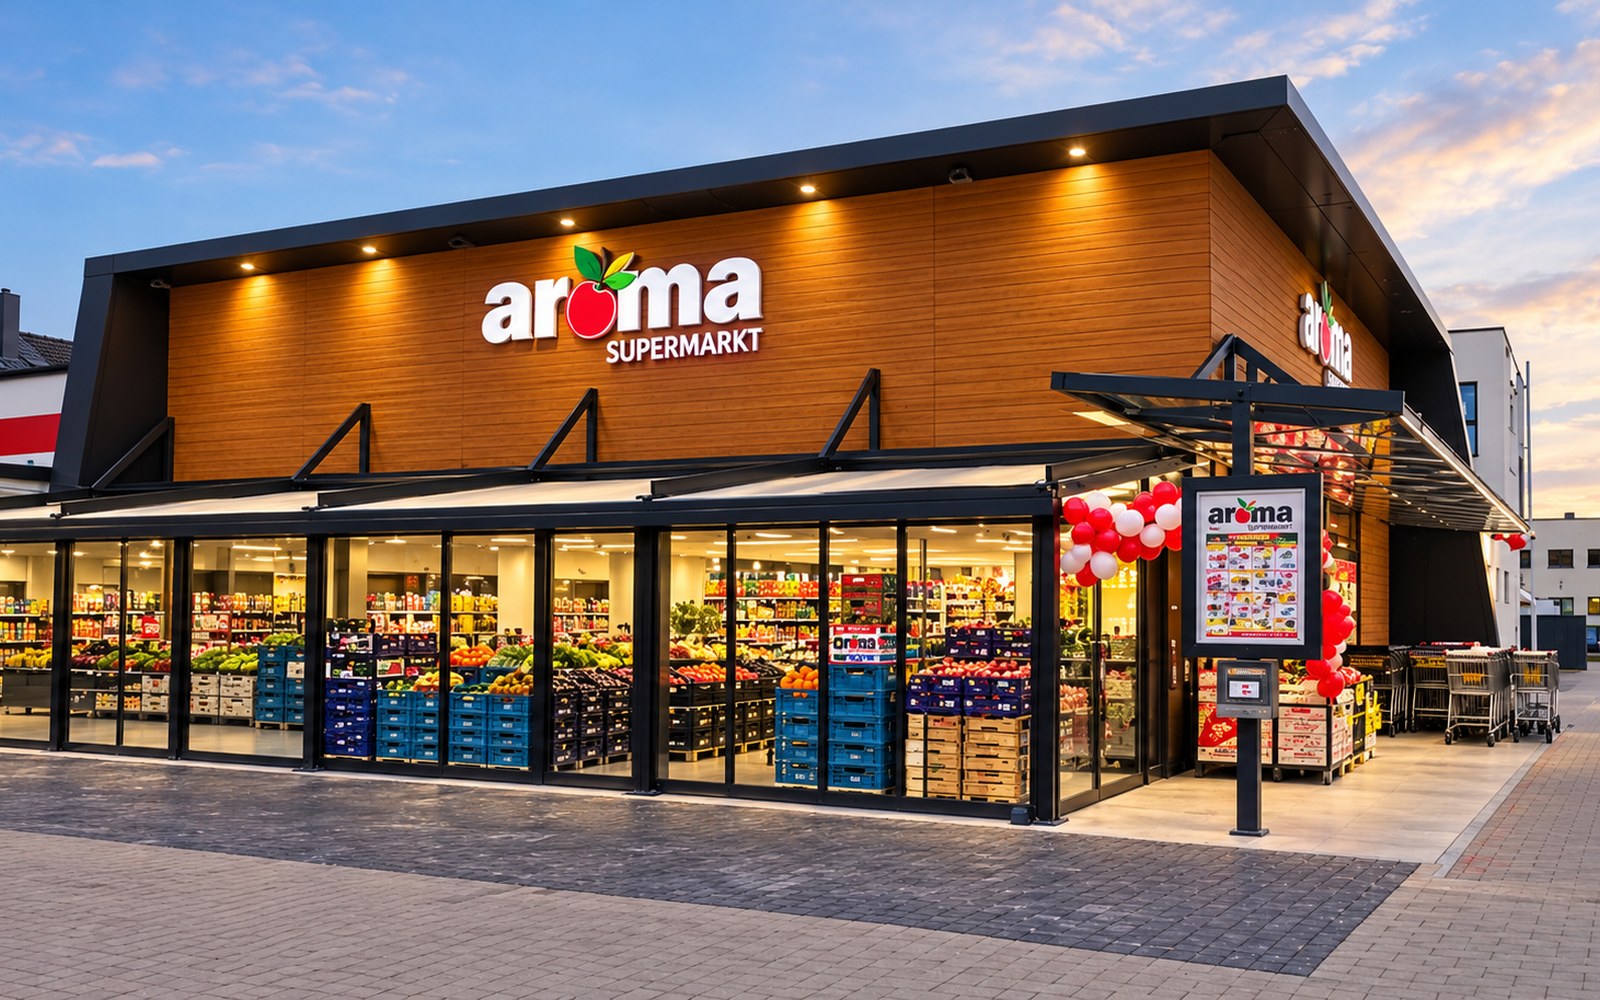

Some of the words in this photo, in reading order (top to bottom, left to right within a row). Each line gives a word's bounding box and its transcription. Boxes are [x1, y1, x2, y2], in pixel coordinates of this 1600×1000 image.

[481, 255, 764, 344] aroma
[606, 327, 764, 364] SUPERMARKT
[1299, 292, 1352, 384] aroma
[1208, 505, 1293, 524] aroma
